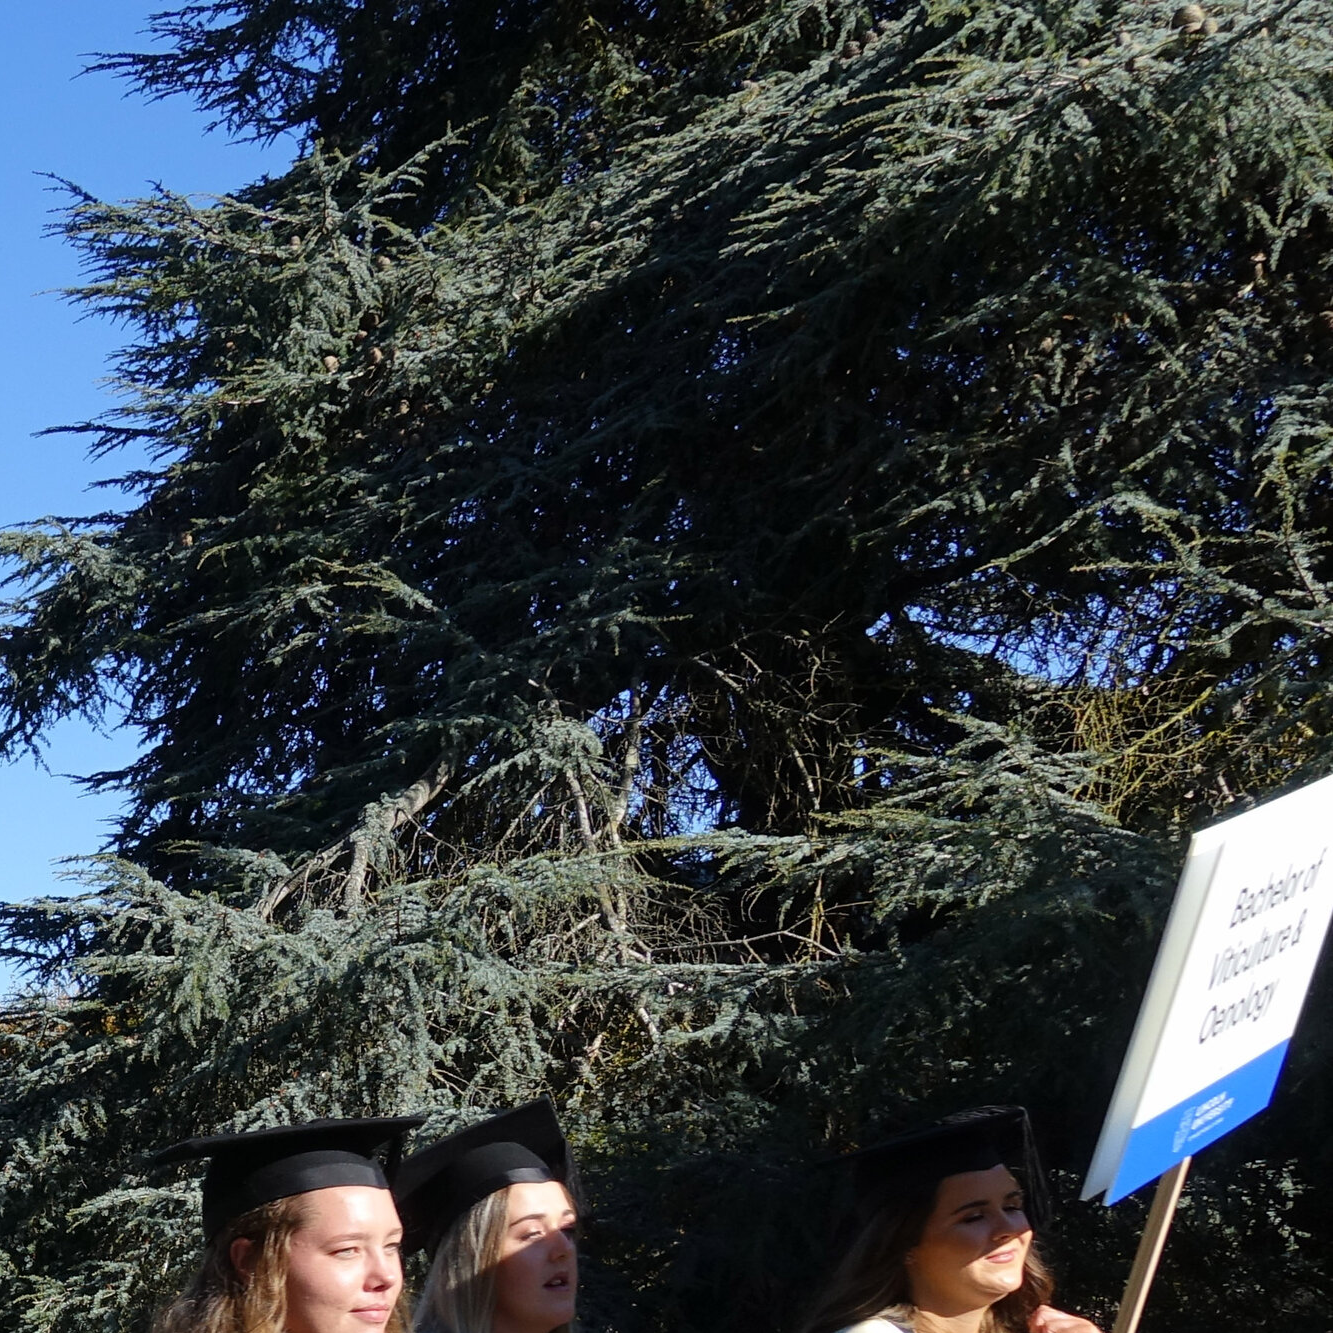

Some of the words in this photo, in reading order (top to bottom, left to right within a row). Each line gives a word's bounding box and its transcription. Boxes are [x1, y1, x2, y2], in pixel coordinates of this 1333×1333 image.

[1230, 864, 1304, 928] Bachelor
[1303, 847, 1328, 892] of
[1208, 926, 1292, 990] Viticulture
[1292, 908, 1308, 946] &
[1199, 978, 1280, 1044] Oenology
